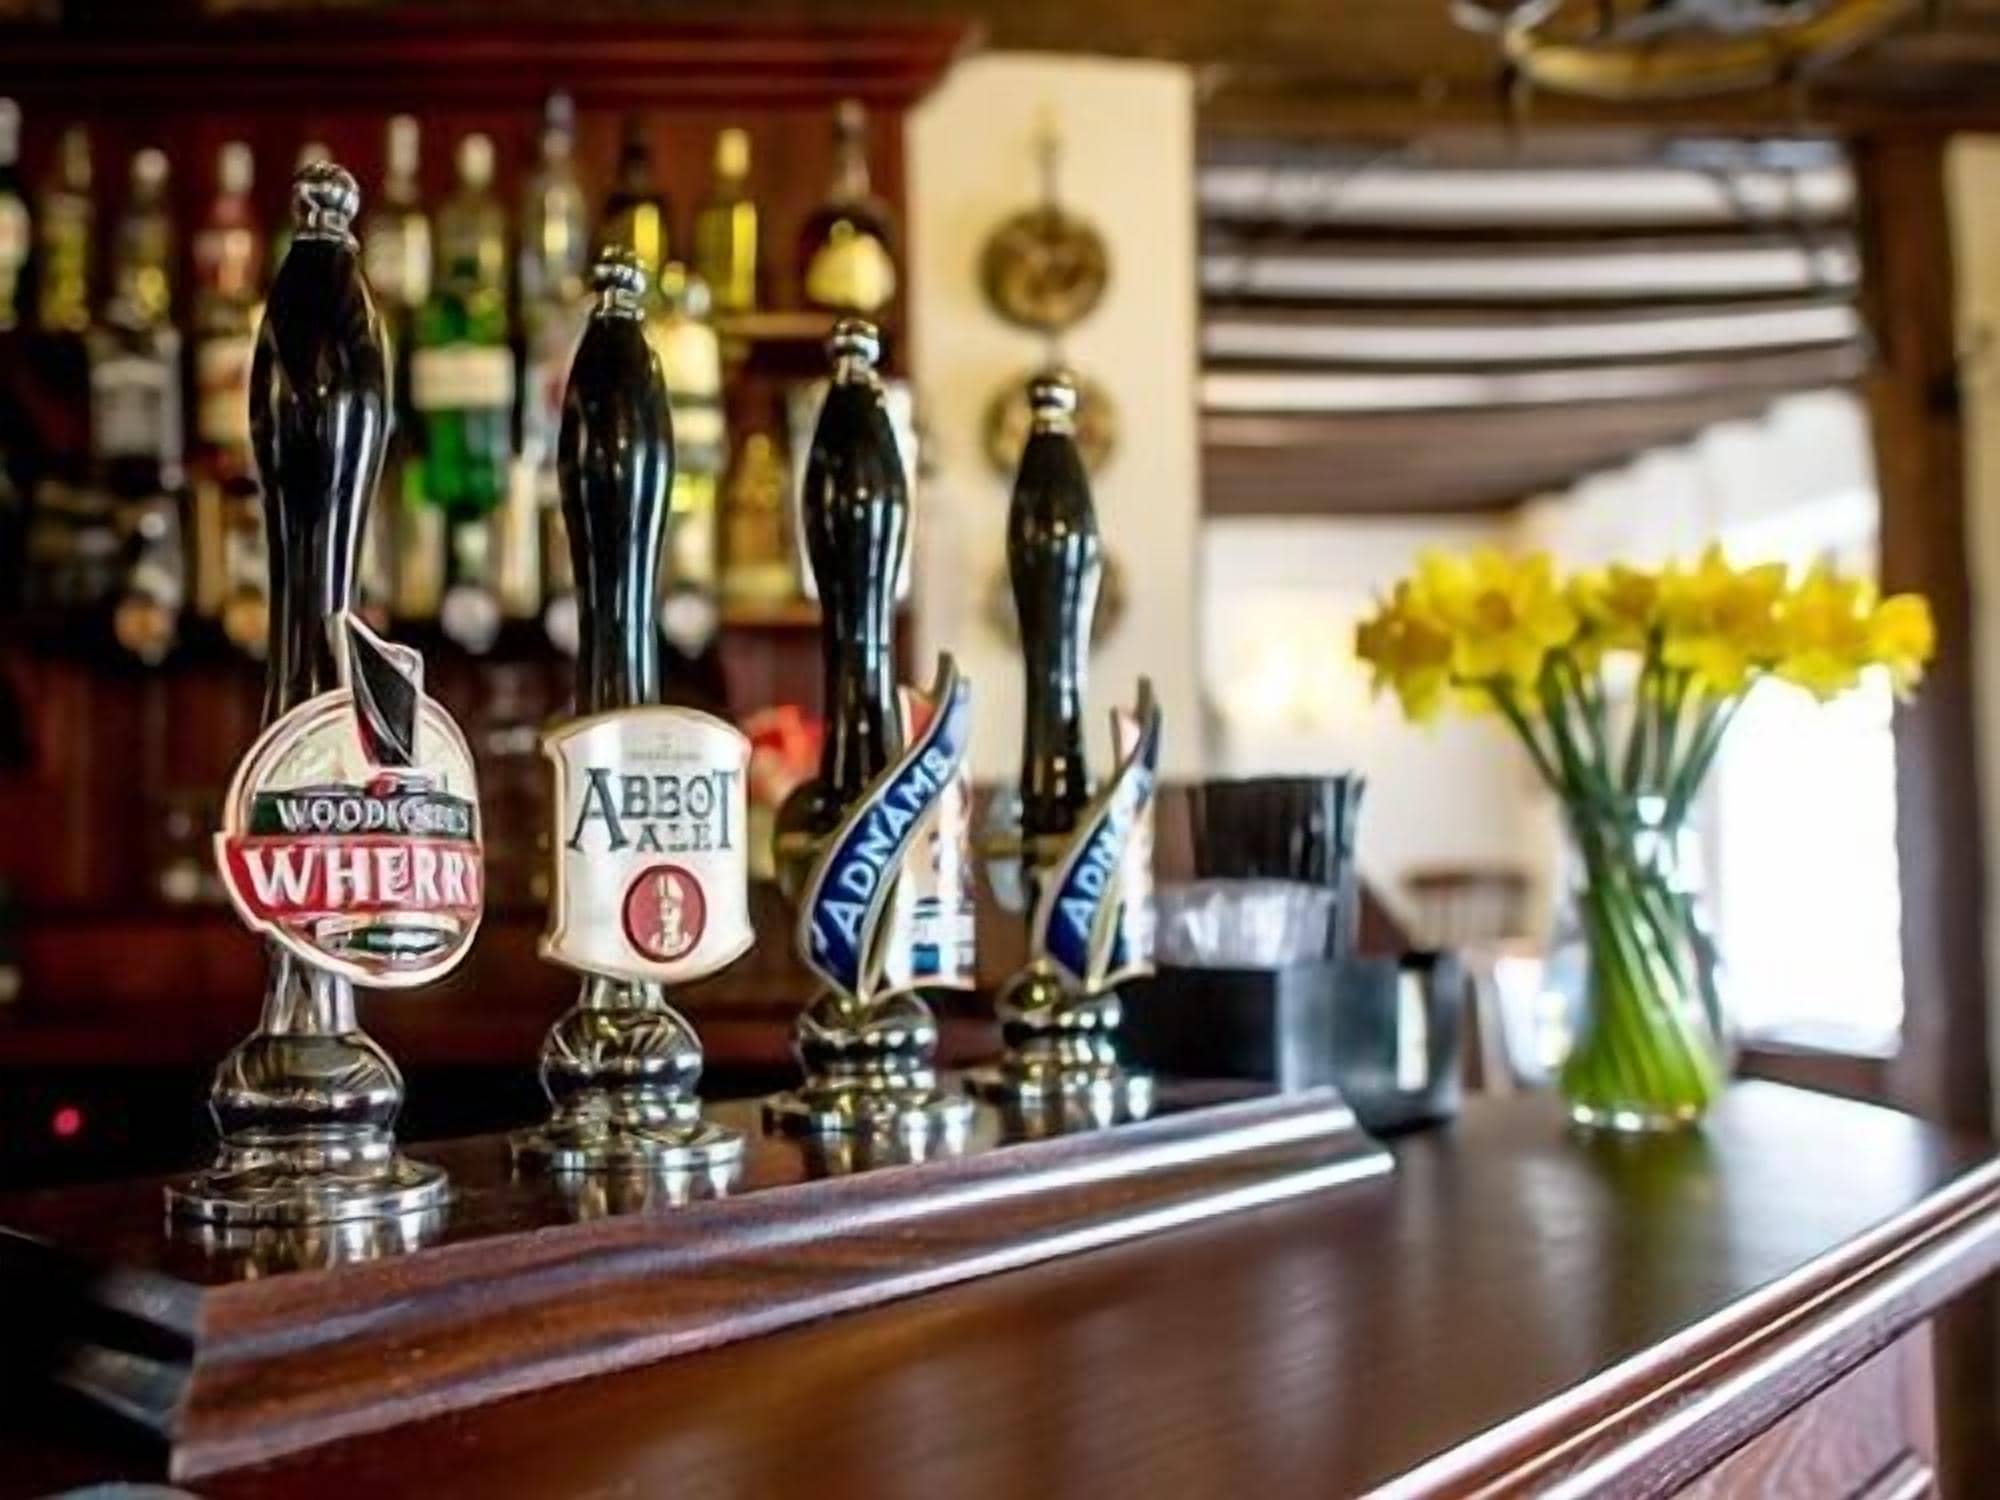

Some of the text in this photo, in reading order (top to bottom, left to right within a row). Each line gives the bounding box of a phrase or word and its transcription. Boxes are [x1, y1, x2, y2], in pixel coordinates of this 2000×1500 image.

[566, 768, 740, 852] ABBOT
[636, 824, 713, 852] ALE
[822, 746, 952, 947] ADNAMS
